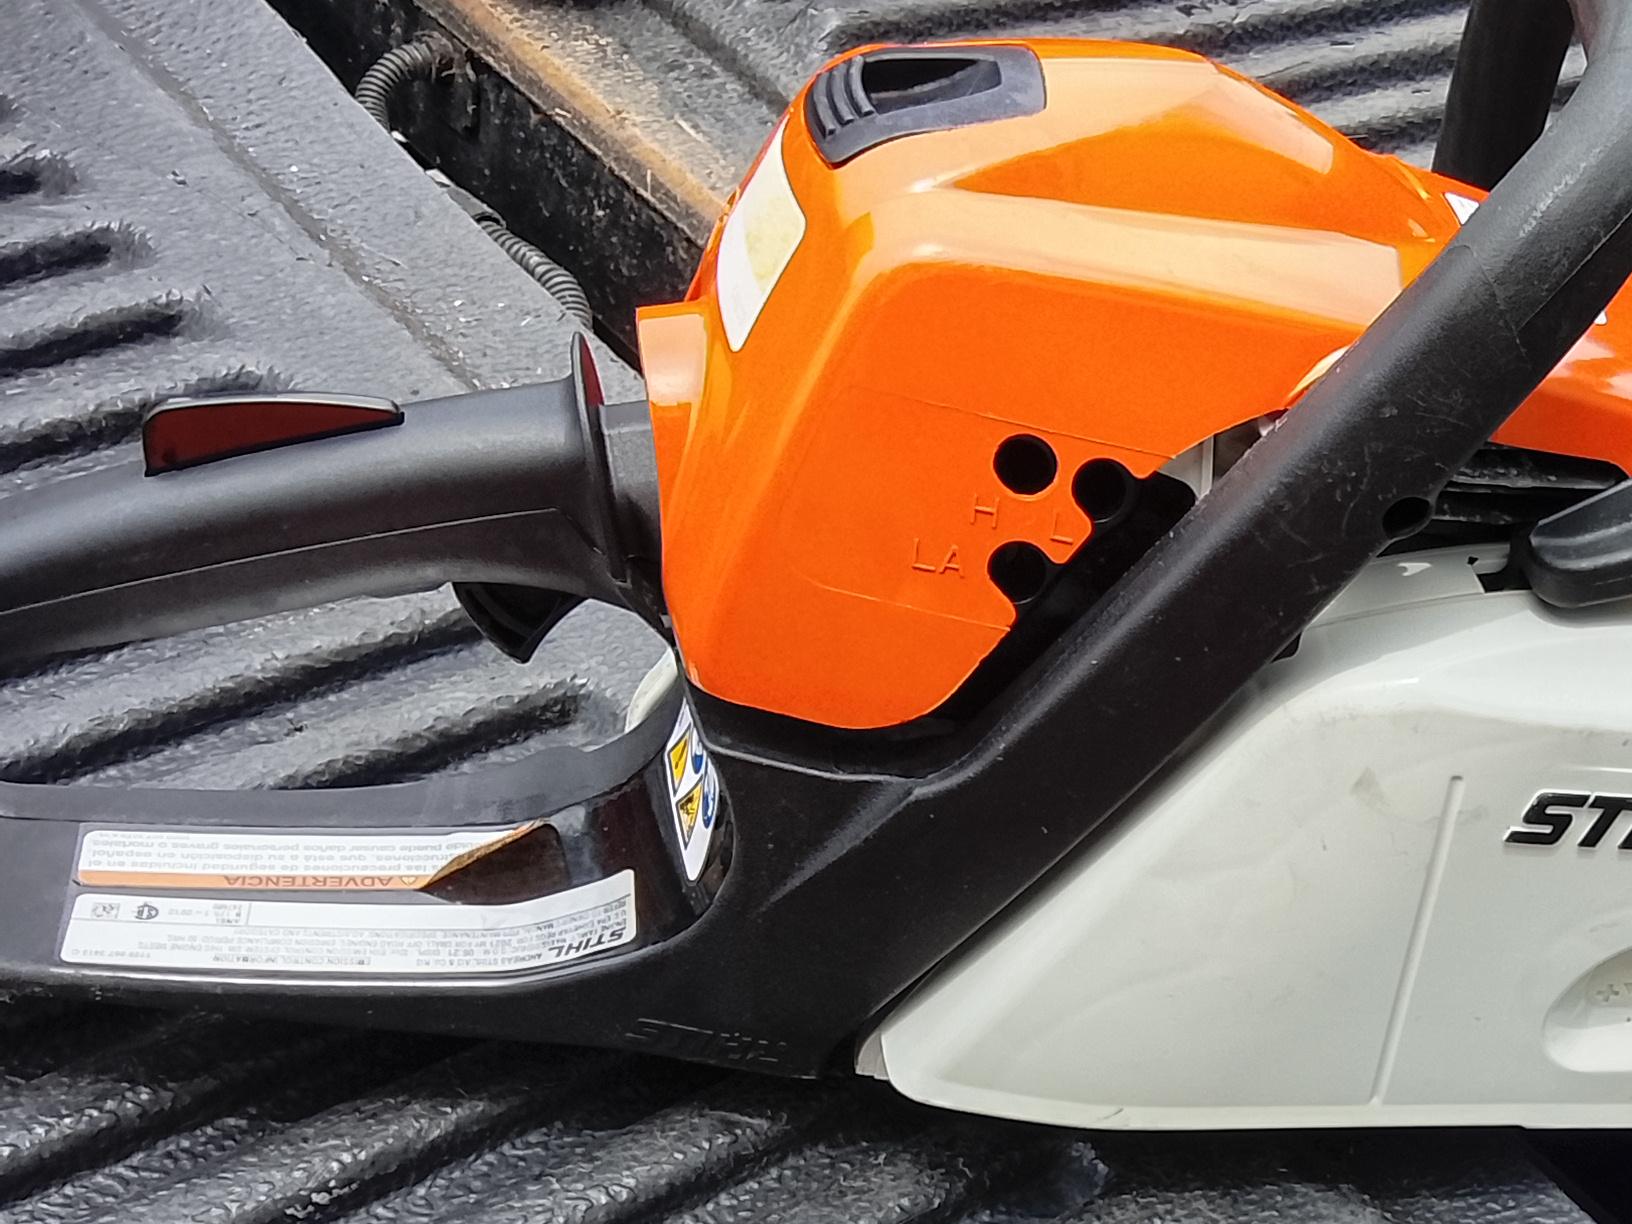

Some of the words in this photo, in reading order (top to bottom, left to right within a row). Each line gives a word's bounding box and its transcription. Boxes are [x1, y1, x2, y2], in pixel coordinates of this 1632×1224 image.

[970, 494, 999, 530] H
[1050, 512, 1074, 545] L
[912, 538, 965, 579] LA
[171, 840, 220, 850] graves
[222, 842, 300, 852] personales
[302, 844, 346, 854] daños
[350, 844, 396, 853] causar
[399, 842, 443, 853] puede
[180, 850, 264, 862] disposición
[340, 852, 366, 862] que
[88, 859, 102, 868] el
[106, 860, 126, 868] en
[131, 860, 198, 871] incluidas
[202, 861, 276, 872] seguridad
[279, 864, 299, 873] de
[303, 862, 401, 872] precauciones
[222, 874, 394, 888] ADVERTENCIA
[548, 926, 626, 958] STIHL
